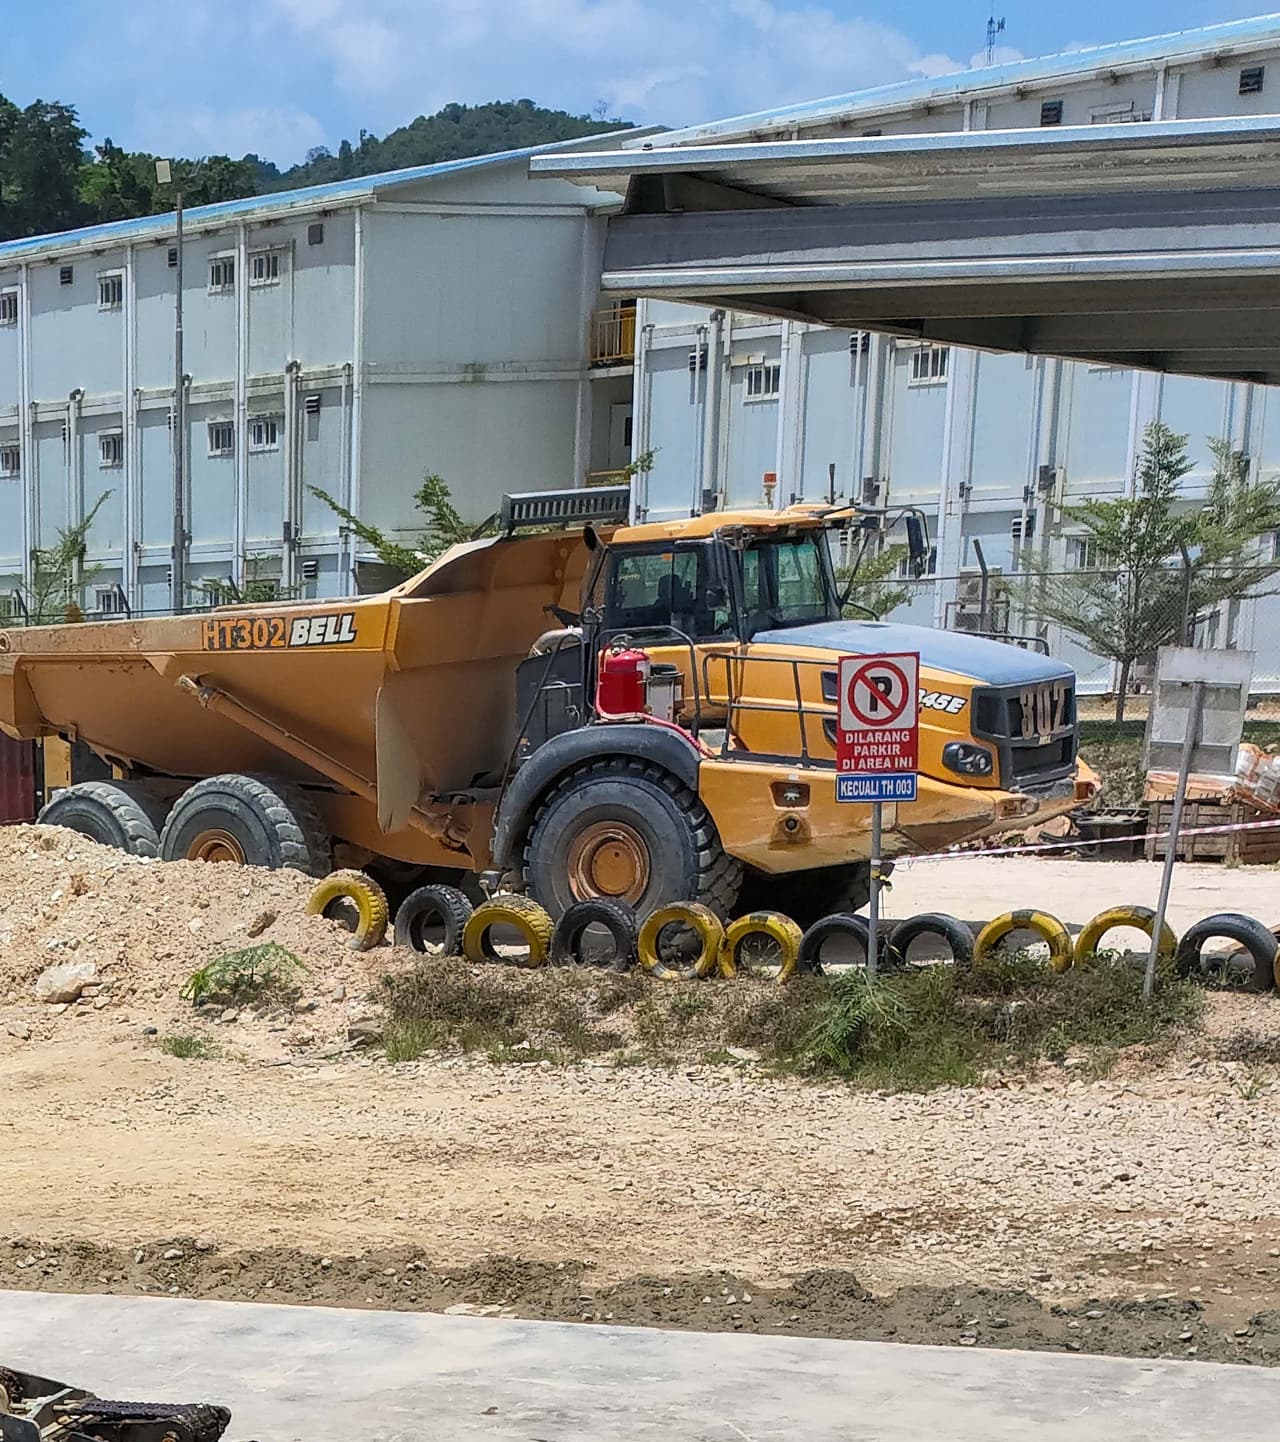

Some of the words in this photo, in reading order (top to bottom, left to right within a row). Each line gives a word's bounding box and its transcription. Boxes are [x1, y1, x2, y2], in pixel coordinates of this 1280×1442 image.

[202, 618, 285, 649] HT302
[290, 613, 356, 646] BELL
[1020, 682, 1068, 740] 302
[845, 731, 910, 744] DILARANG
[854, 744, 901, 757] PARKIR
[842, 759, 855, 770] DI
[858, 758, 892, 769] AREA
[895, 756, 913, 768] INI
[840, 780, 879, 797] KECUALI
[881, 779, 894, 796] TH
[896, 779, 913, 795] 003
